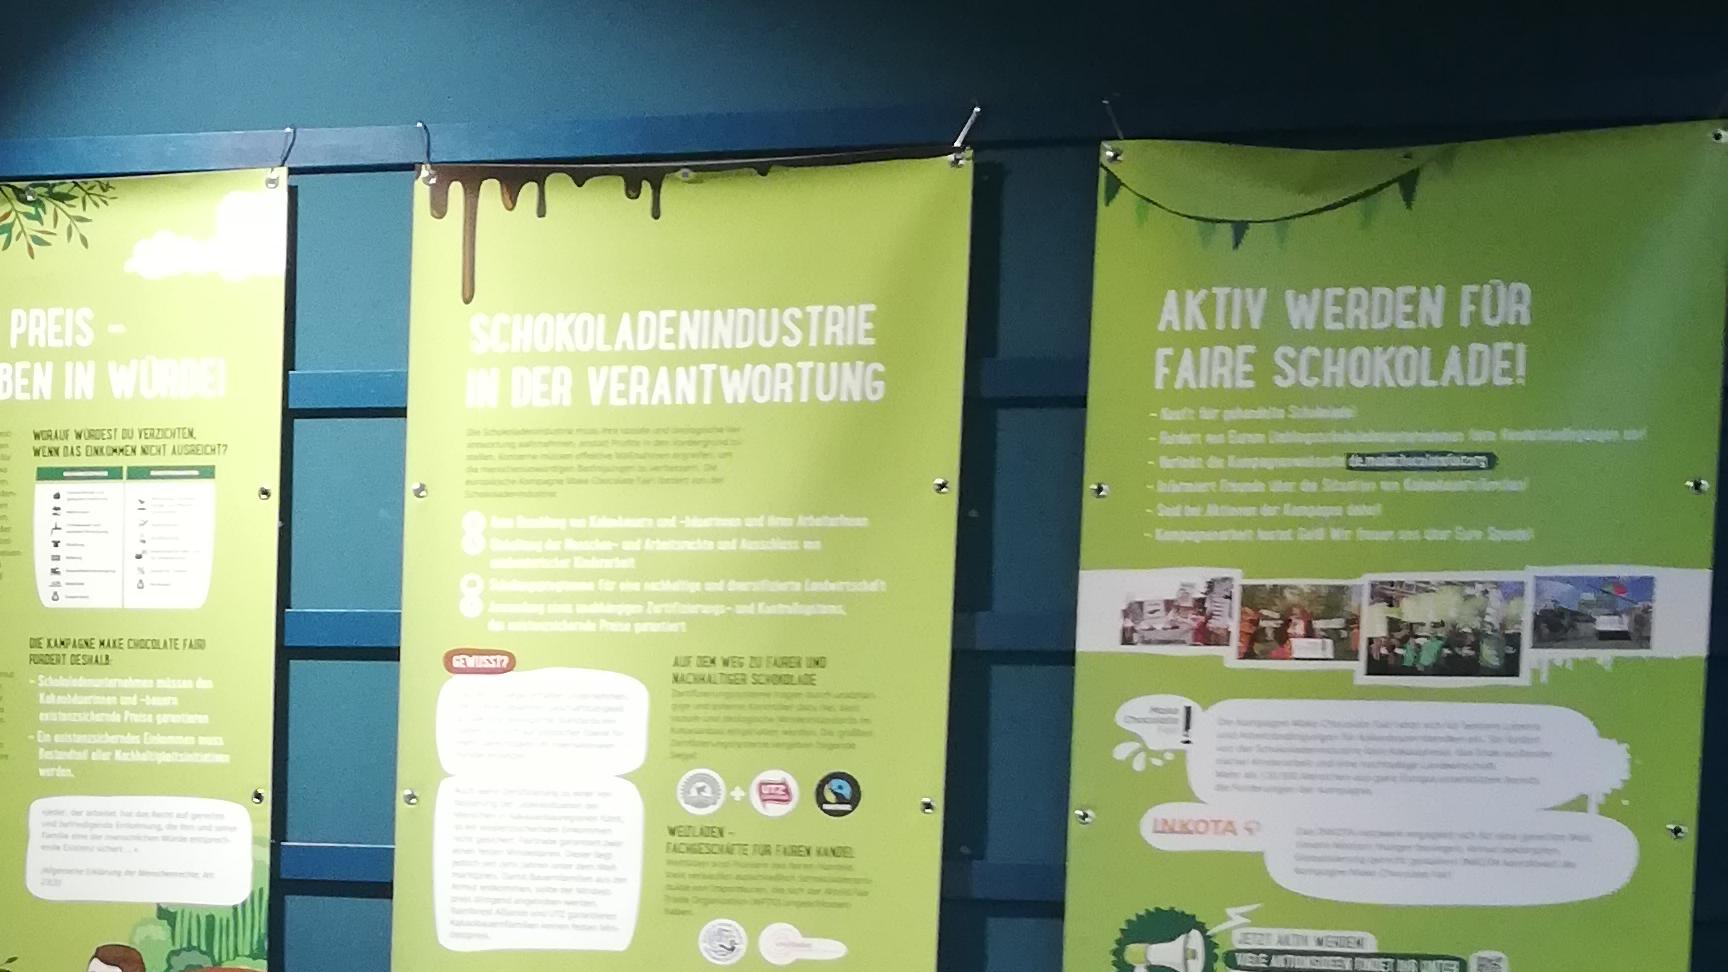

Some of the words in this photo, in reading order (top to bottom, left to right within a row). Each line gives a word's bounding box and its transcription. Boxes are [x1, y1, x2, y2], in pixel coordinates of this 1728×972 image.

[10, 306, 96, 350] PREIS
[468, 303, 878, 355] SCHOKOLADENINDUSTRIE
[1157, 286, 1268, 332] AKTIV
[1284, 284, 1446, 331] WERDEN
[1459, 278, 1534, 328] FÜR
[65, 361, 96, 402] IN
[464, 366, 499, 410] IN
[510, 365, 575, 410] DER
[586, 360, 886, 408] VERANTWORTUNG
[1153, 344, 1257, 390] FAIRE
[1272, 341, 1527, 390] SCHOKOLADE!
[1152, 817, 1239, 836] INKOTA
